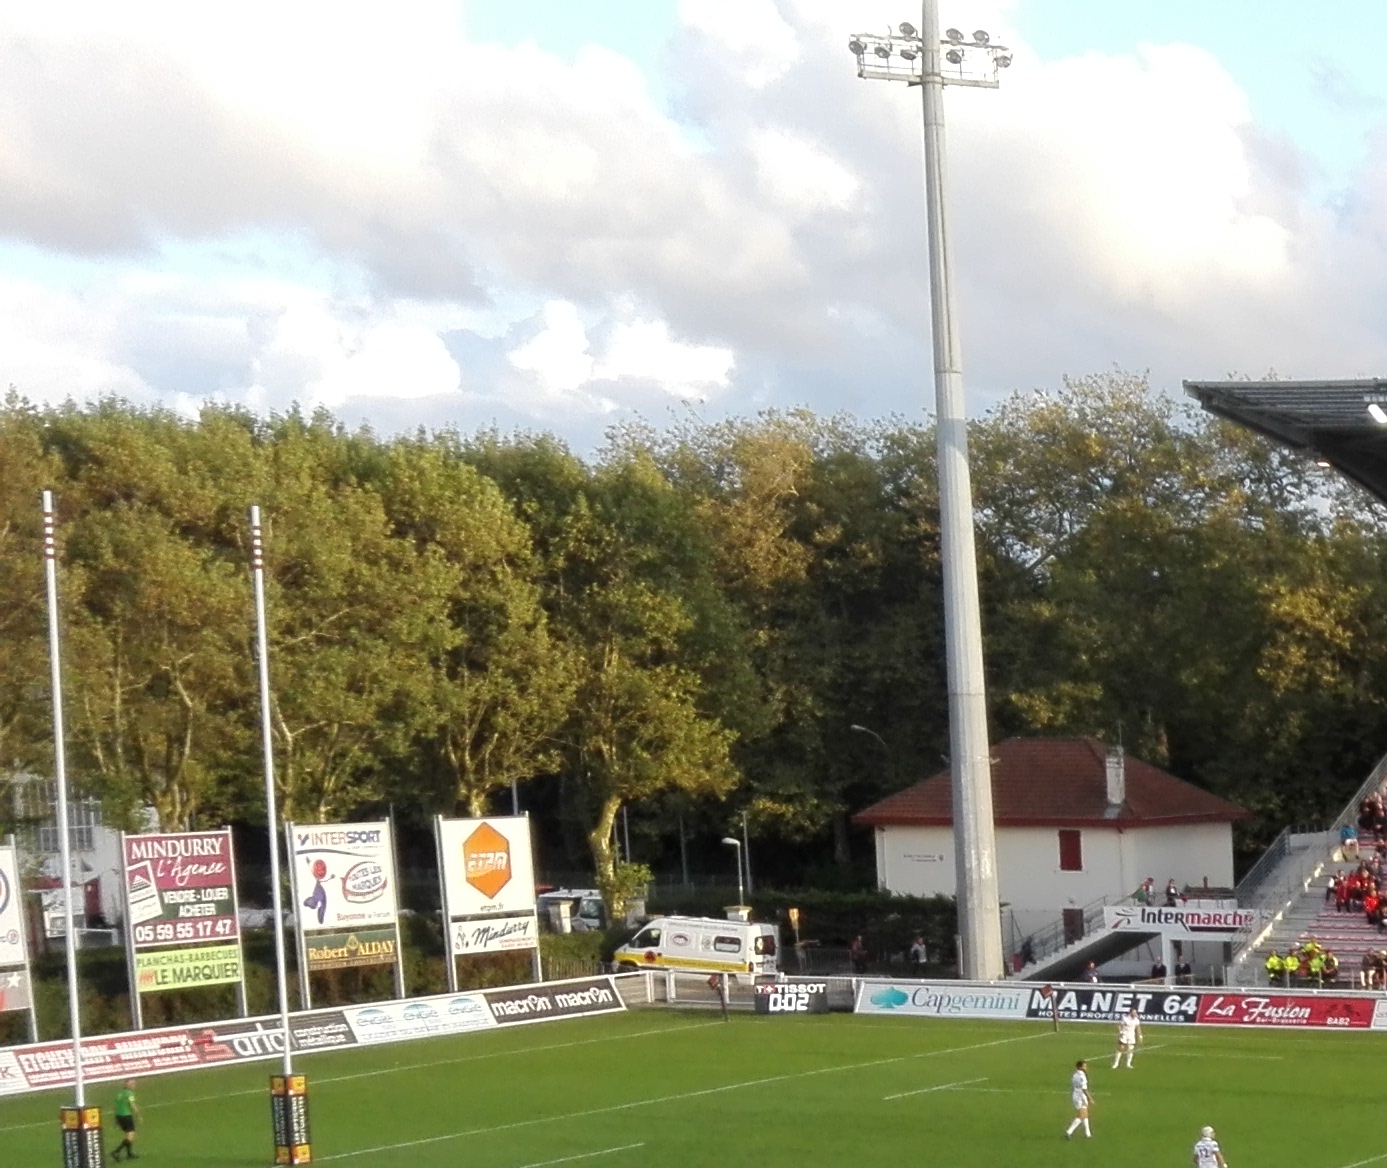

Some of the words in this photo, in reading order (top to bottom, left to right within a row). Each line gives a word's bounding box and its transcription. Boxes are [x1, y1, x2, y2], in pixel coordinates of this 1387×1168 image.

[311, 830, 381, 846] INTERSPORT
[131, 838, 223, 860] MINDURRY
[163, 890, 196, 904] VENDRE
[202, 888, 229, 900] LOUER
[178, 903, 217, 918] ACHETER
[136, 926, 154, 942] 05
[156, 924, 174, 940] 59
[176, 923, 194, 938] 55
[196, 921, 212, 936] 17
[215, 919, 232, 935] 47
[471, 920, 530, 949] Mindurry
[308, 947, 348, 961] Robert
[357, 940, 396, 956] ALDAY
[155, 968, 168, 985] LE
[172, 962, 239, 984] MARQUIER
[555, 987, 614, 1009] macron
[775, 983, 826, 995] TISSOT
[491, 994, 552, 1017] macron
[912, 988, 1020, 1016] Capgemini
[1163, 994, 1198, 1015] 64
[1206, 995, 1237, 1017] La
[1241, 996, 1312, 1023] Fusion
[1080, 1012, 1186, 1023] PROFESSNNELLES
[293, 1022, 350, 1038] construction
